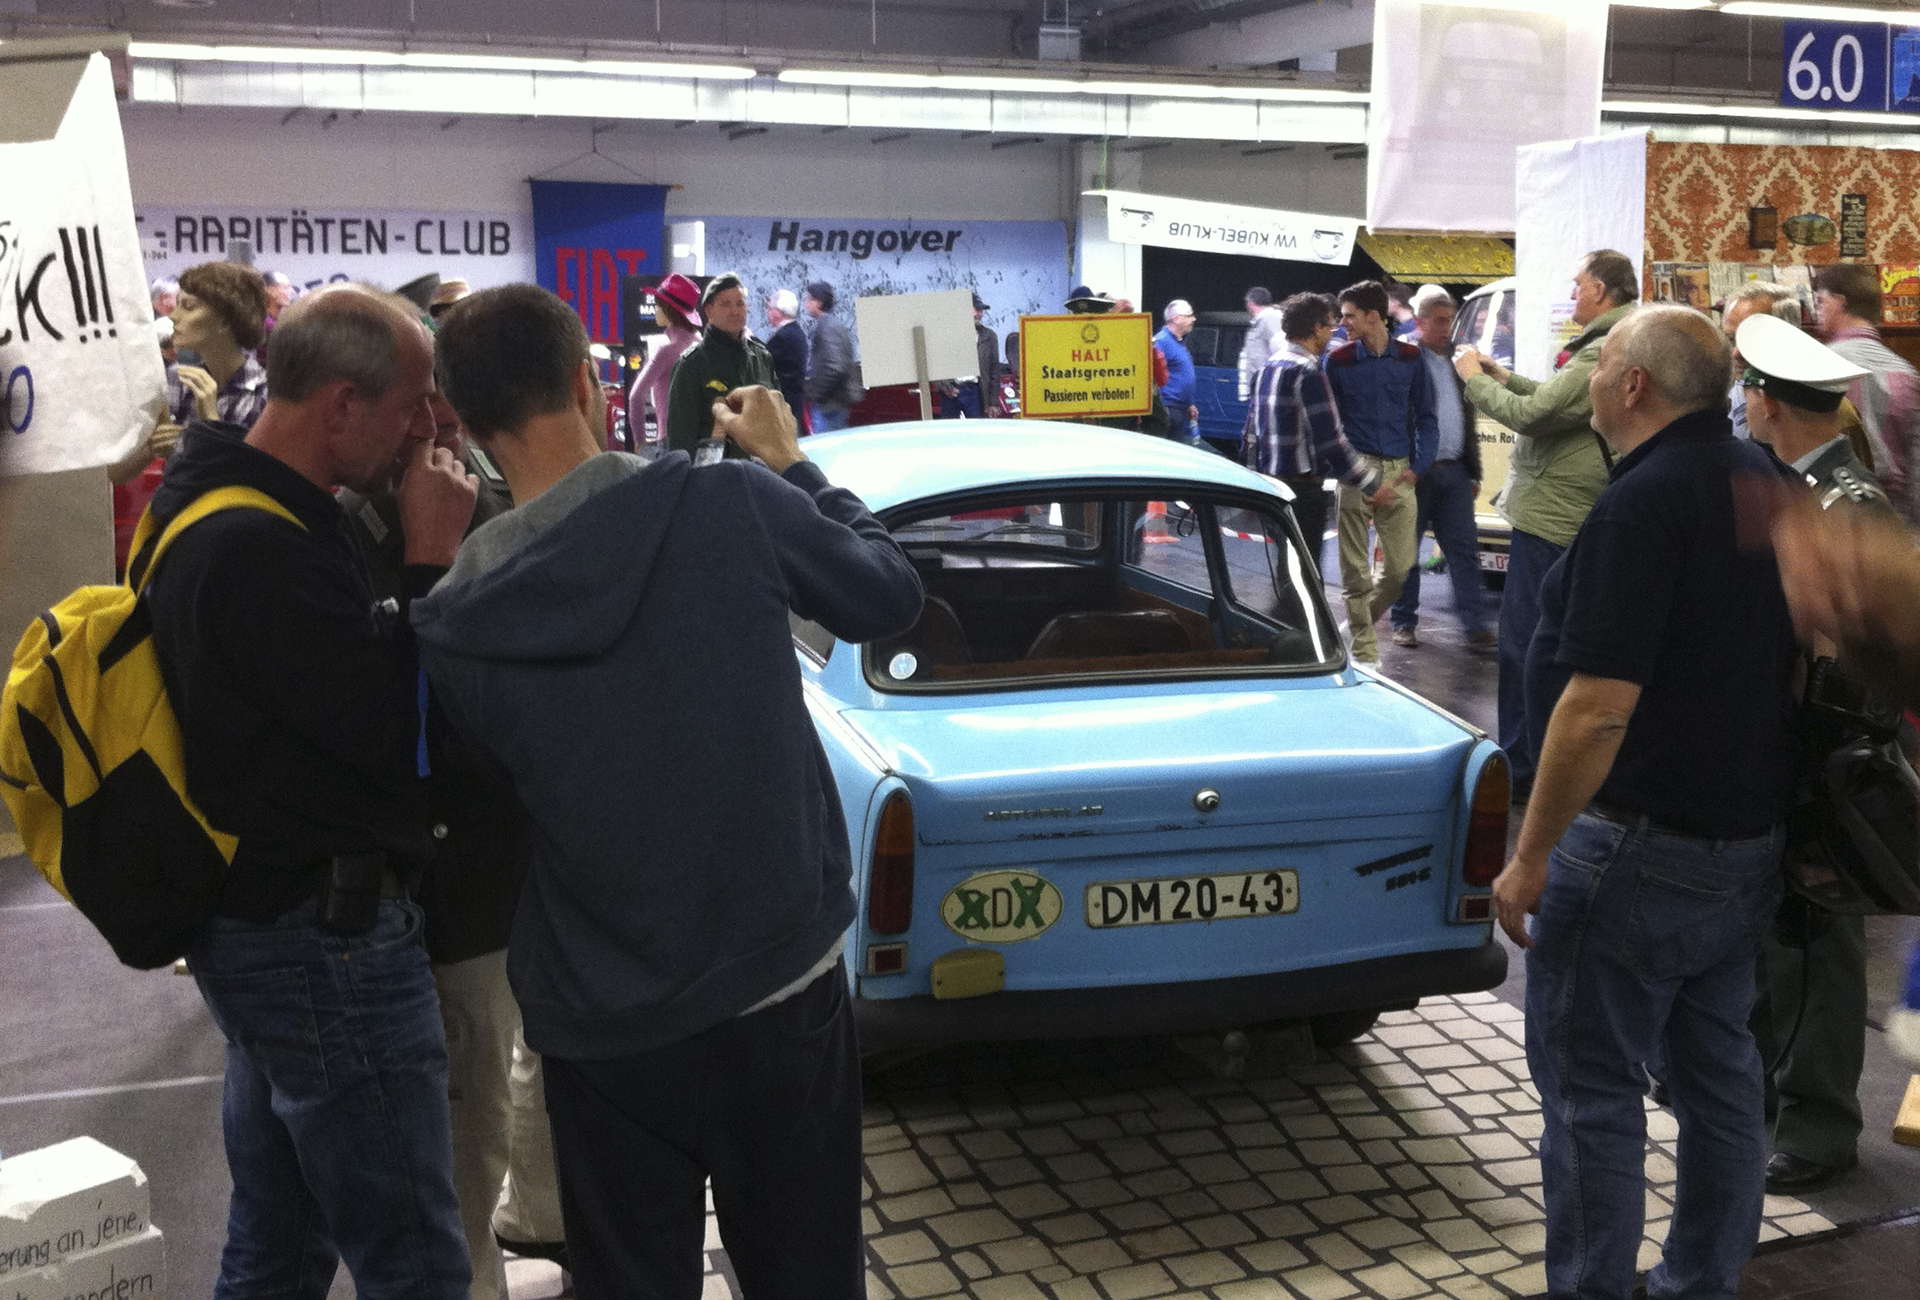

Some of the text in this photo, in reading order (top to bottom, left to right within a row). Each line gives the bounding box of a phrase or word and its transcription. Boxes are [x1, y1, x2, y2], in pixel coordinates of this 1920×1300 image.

[1787, 31, 1864, 103] 6.0
[135, 209, 511, 256] -RARITÄTEN-CLUB
[768, 221, 963, 260] Hangover
[1273, 234, 1298, 249] VW
[0, 224, 117, 346] K!!!
[1071, 348, 1110, 362] HALT
[1042, 365, 1136, 381] Staatsgrenze!
[1043, 386, 1135, 402] Passieren verboten!
[1102, 872, 1284, 925] DM 20-43
[57, 1229, 84, 1252] an
